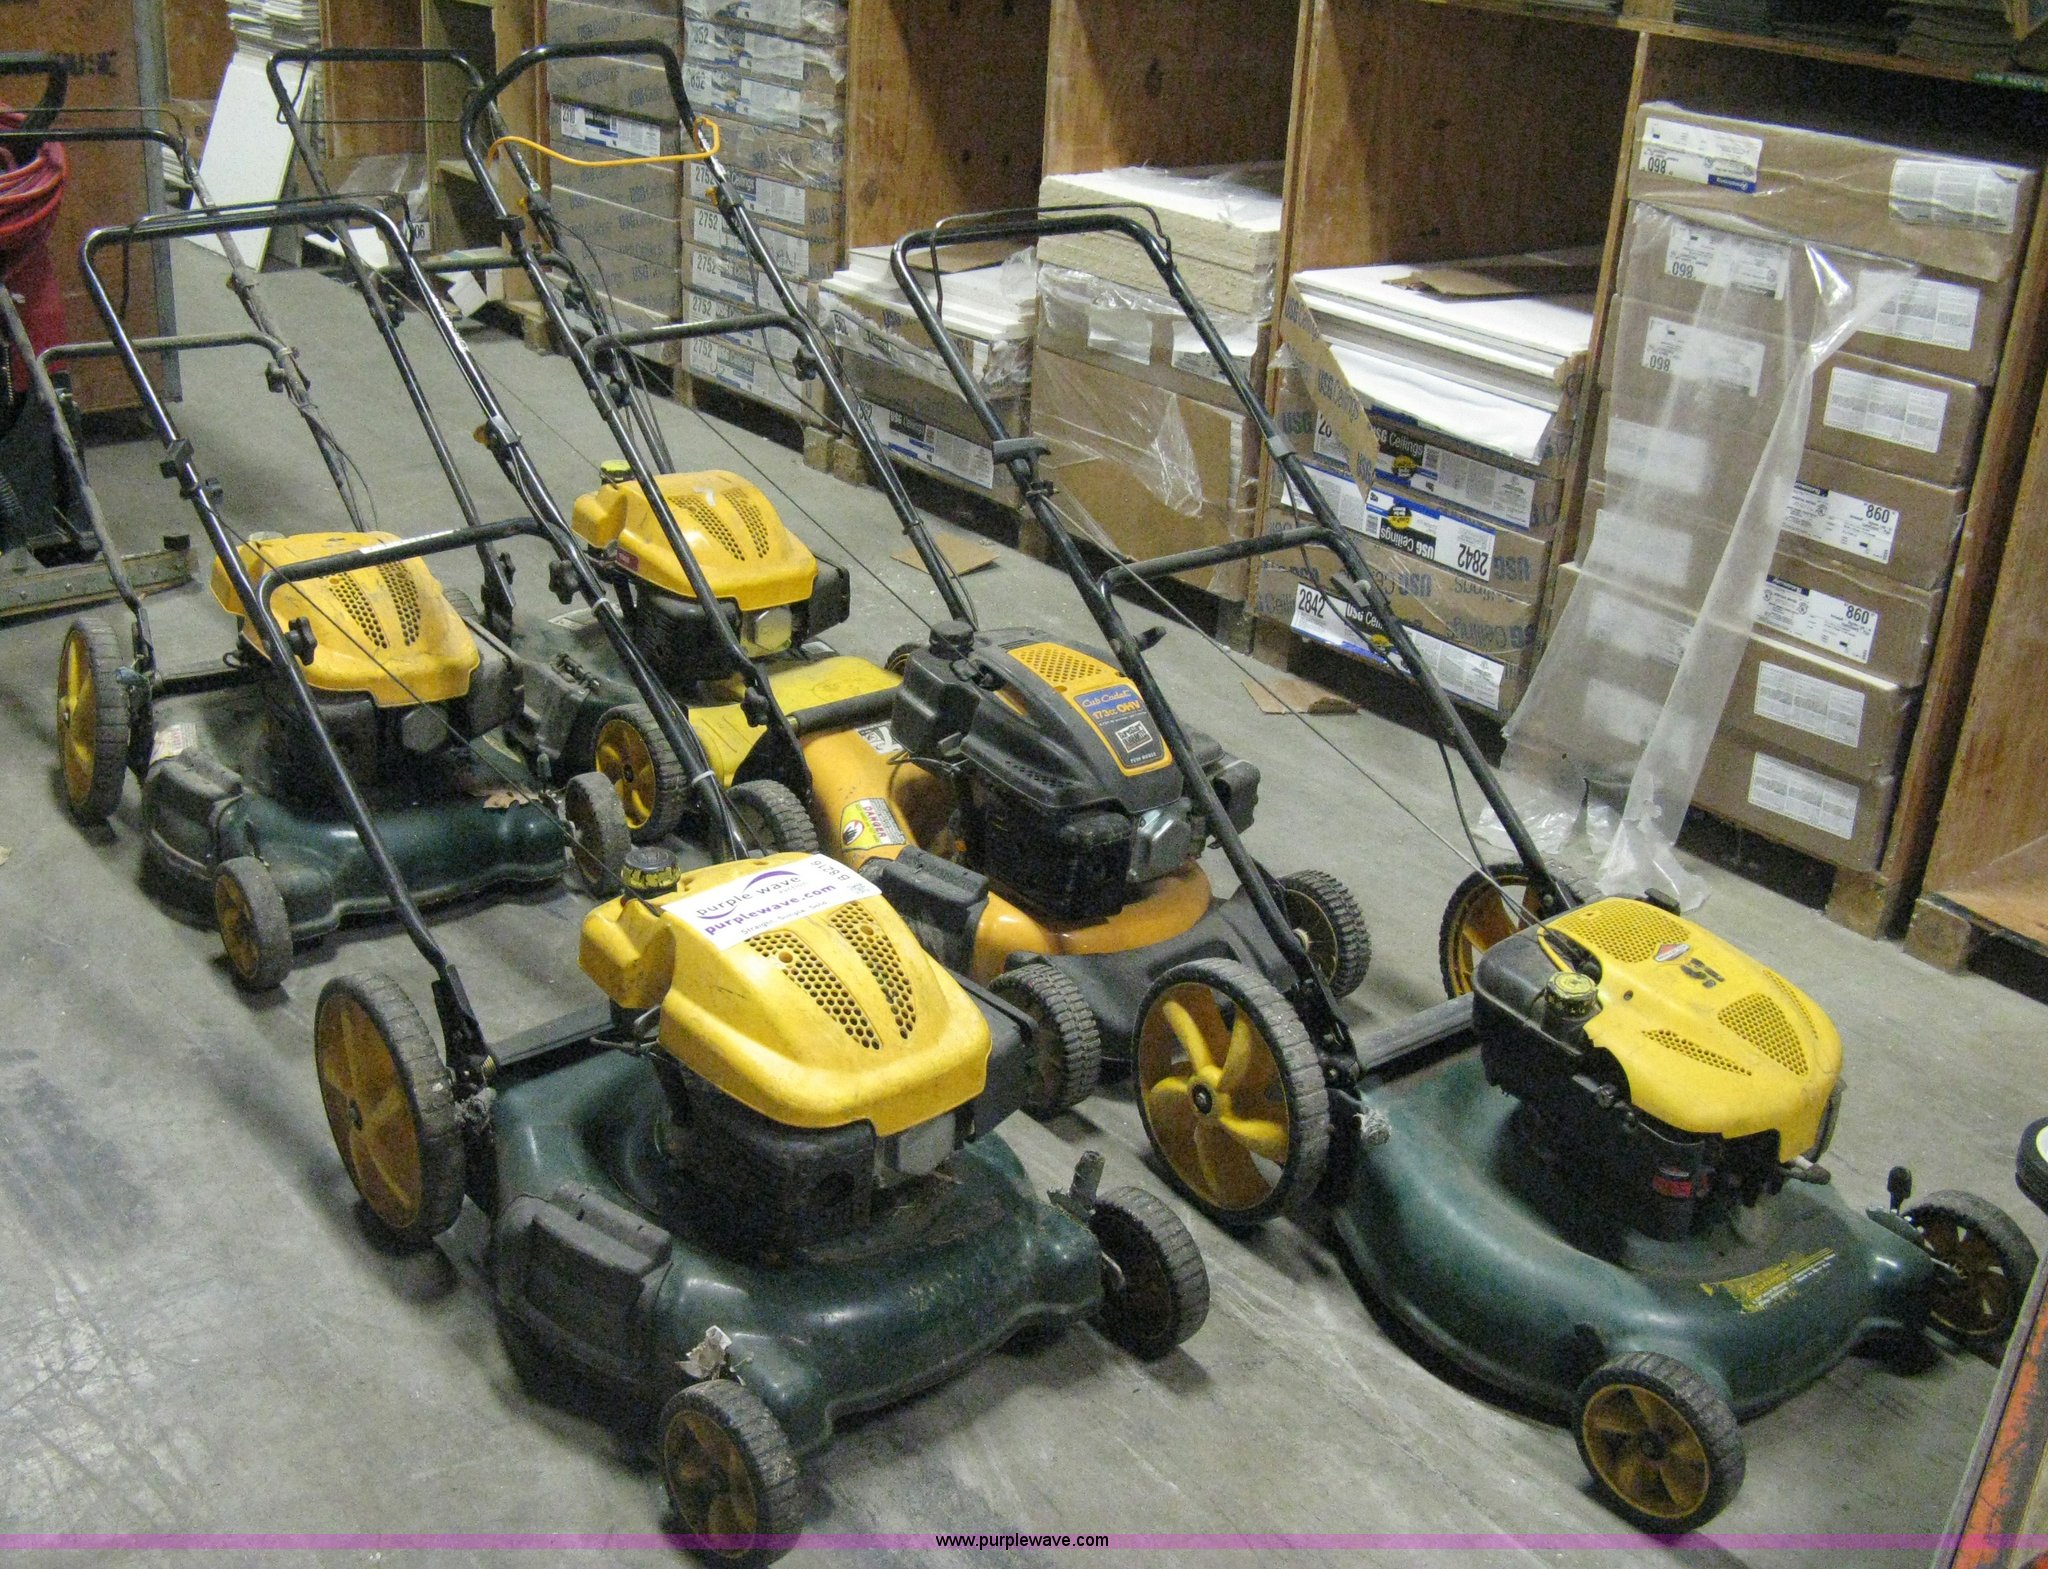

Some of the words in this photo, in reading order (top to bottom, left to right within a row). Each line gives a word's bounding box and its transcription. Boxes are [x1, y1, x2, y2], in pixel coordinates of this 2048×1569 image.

[698, 210, 719, 231] 2752
[697, 253, 717, 275] 2752
[1388, 431, 1424, 457] Ceilings
[1865, 504, 1891, 524] 860
[1380, 525, 1414, 552] Ceilings
[1415, 541, 1435, 560] USG
[1298, 587, 1326, 619] 2842
[1845, 604, 1871, 625] 860
[863, 805, 888, 838] DANGER
[696, 893, 753, 916] purple
[755, 876, 801, 895] wave
[704, 884, 837, 936] purplewave.com
